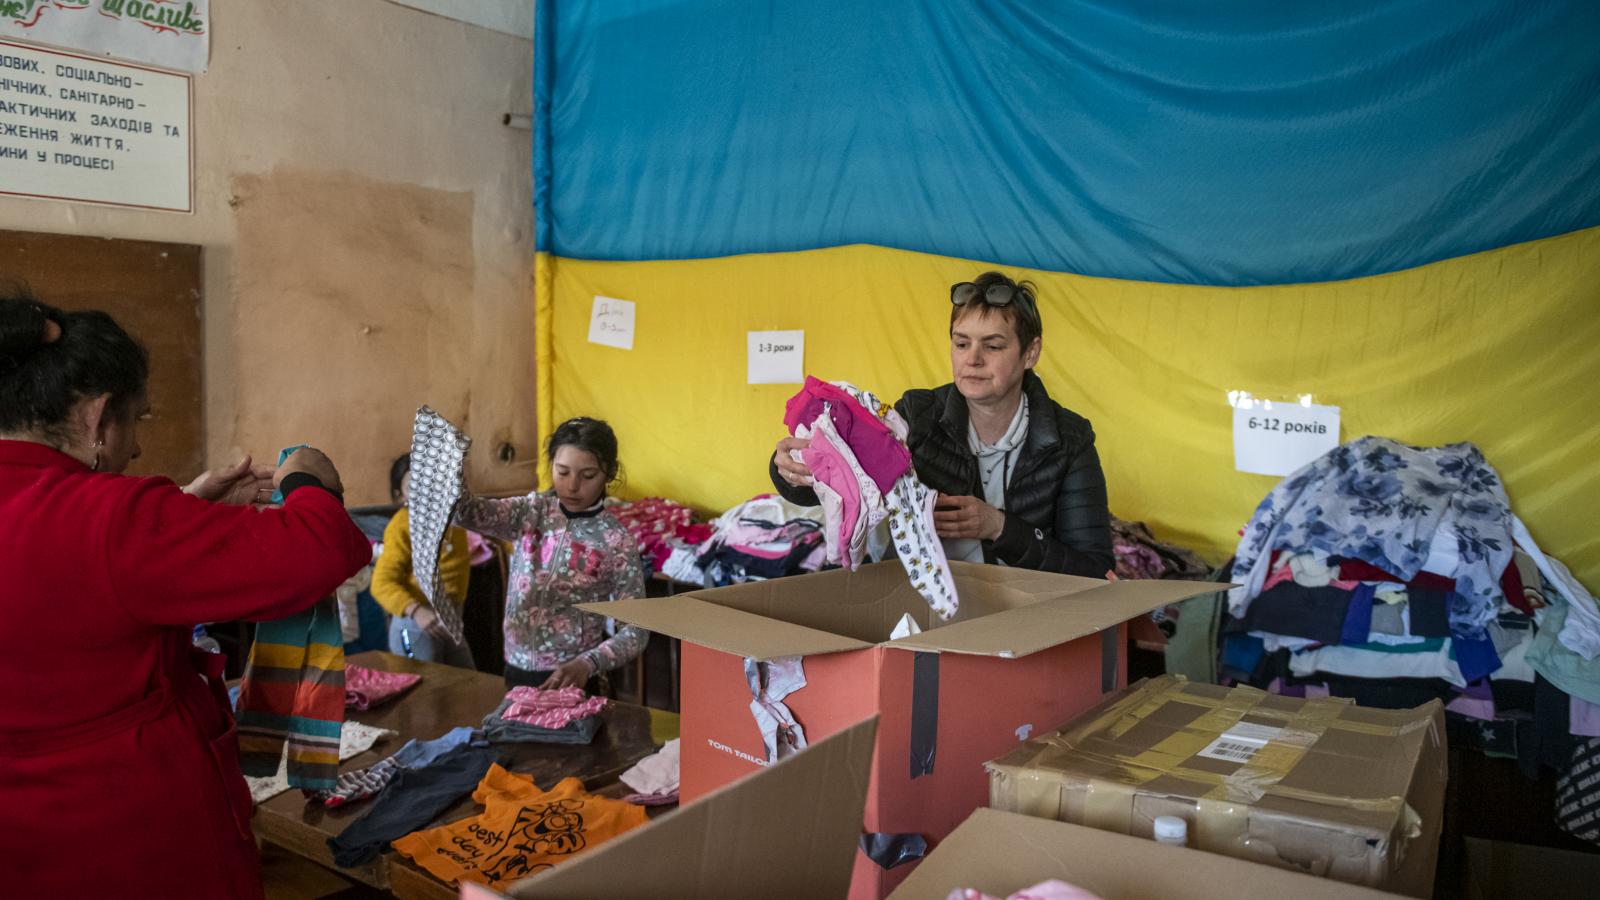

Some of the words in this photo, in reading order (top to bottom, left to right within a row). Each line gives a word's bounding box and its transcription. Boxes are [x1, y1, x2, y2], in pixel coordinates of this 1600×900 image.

[91, 114, 152, 134] ЗАХОДІВ
[163, 125, 180, 137] ТА
[38, 151, 46, 162] У
[55, 153, 114, 170] ПРОЦЕСІ
[759, 343, 772, 352] 1-3
[773, 345, 794, 354] роки
[1249, 417, 1280, 431] 6-12
[1284, 421, 1327, 434] років
[708, 739, 732, 754] TOM
